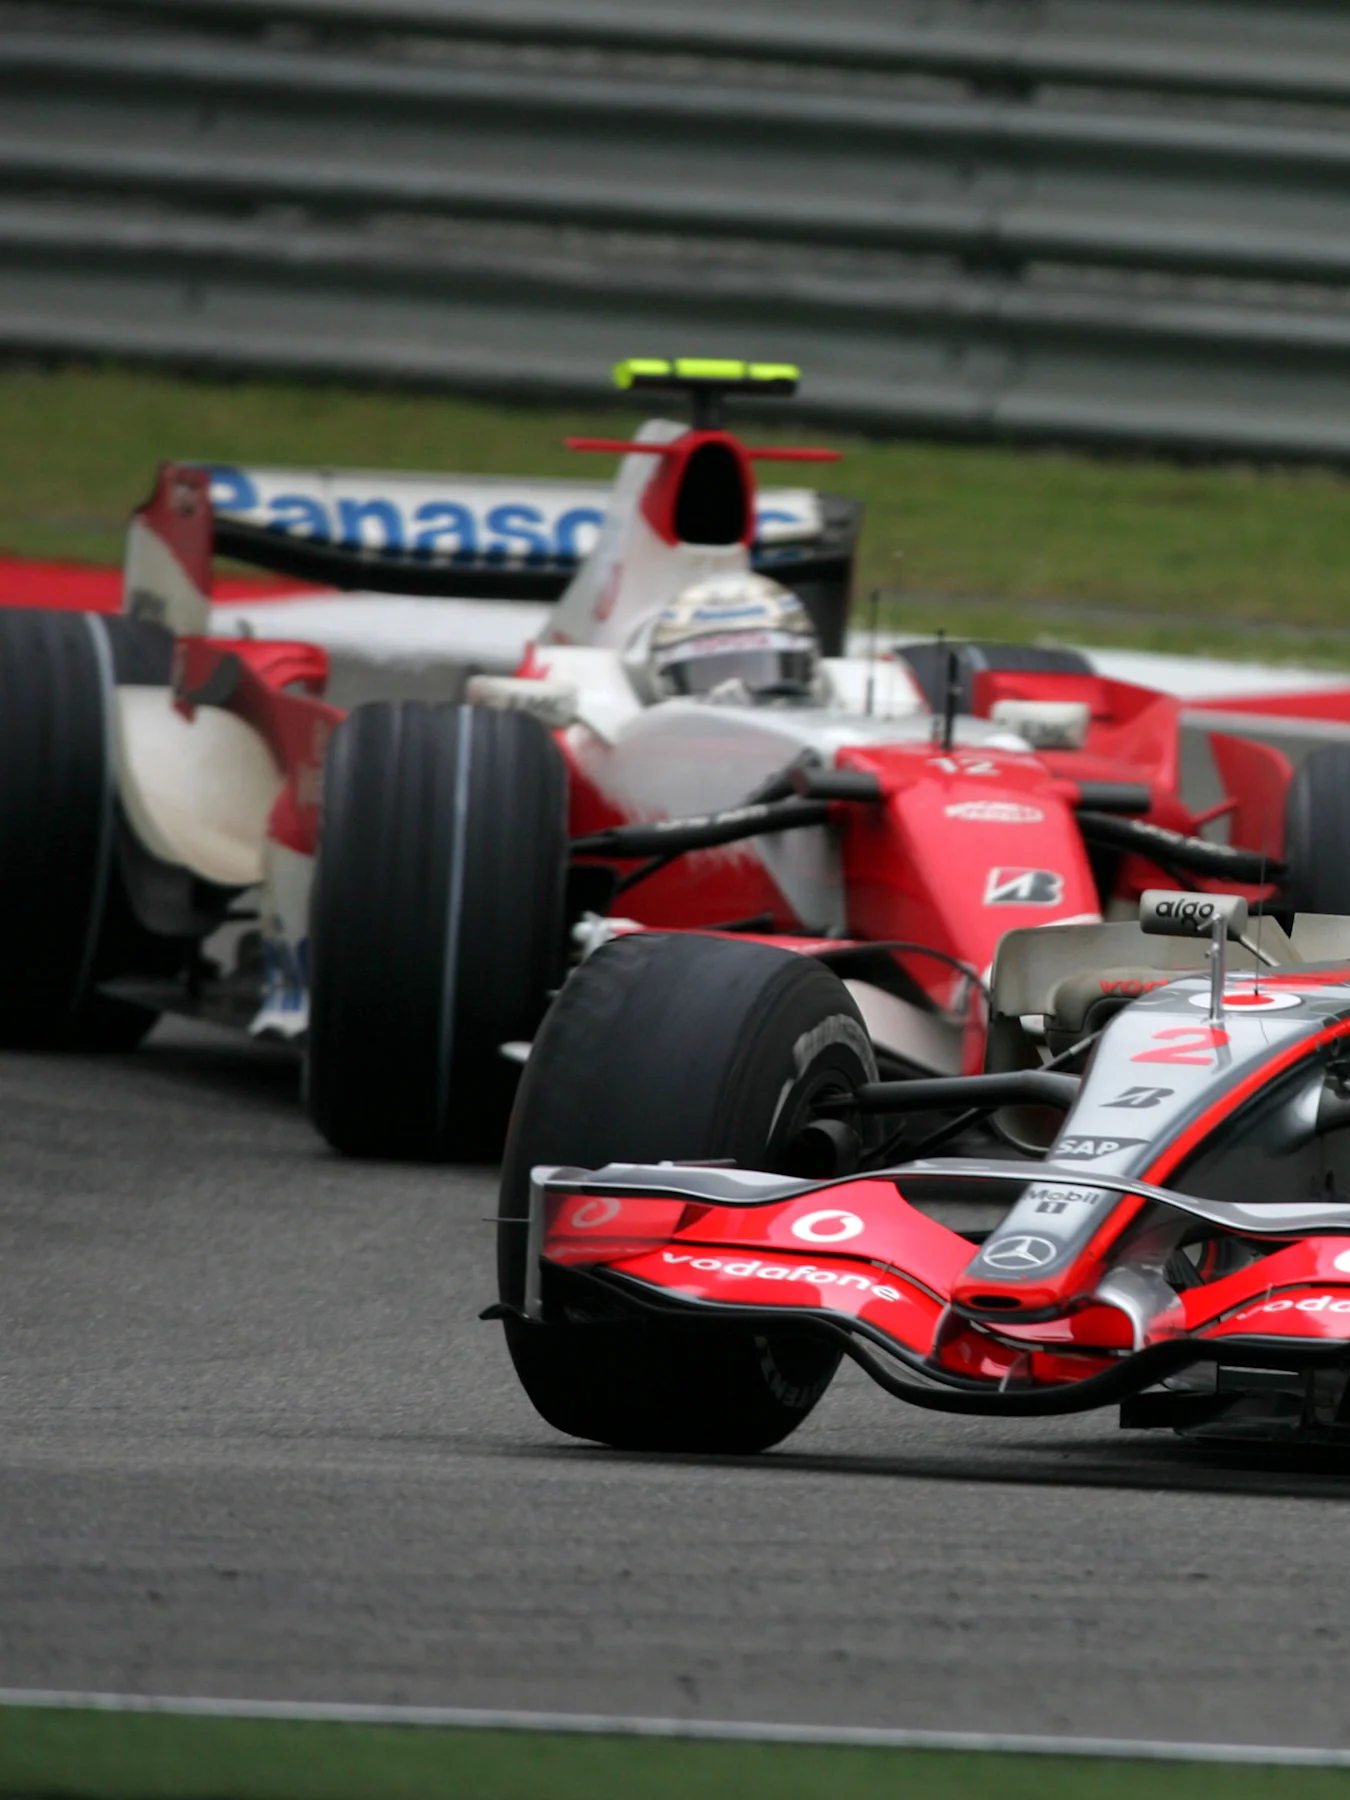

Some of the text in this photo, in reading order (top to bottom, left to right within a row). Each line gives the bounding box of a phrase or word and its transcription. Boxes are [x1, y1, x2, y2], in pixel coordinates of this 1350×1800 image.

[926, 757, 1001, 776] 12
[1130, 1026, 1231, 1065] 2
[1055, 1139, 1119, 1155] SAP
[1028, 1189, 1099, 1205] Mobil
[661, 1251, 901, 1303] vodafone
